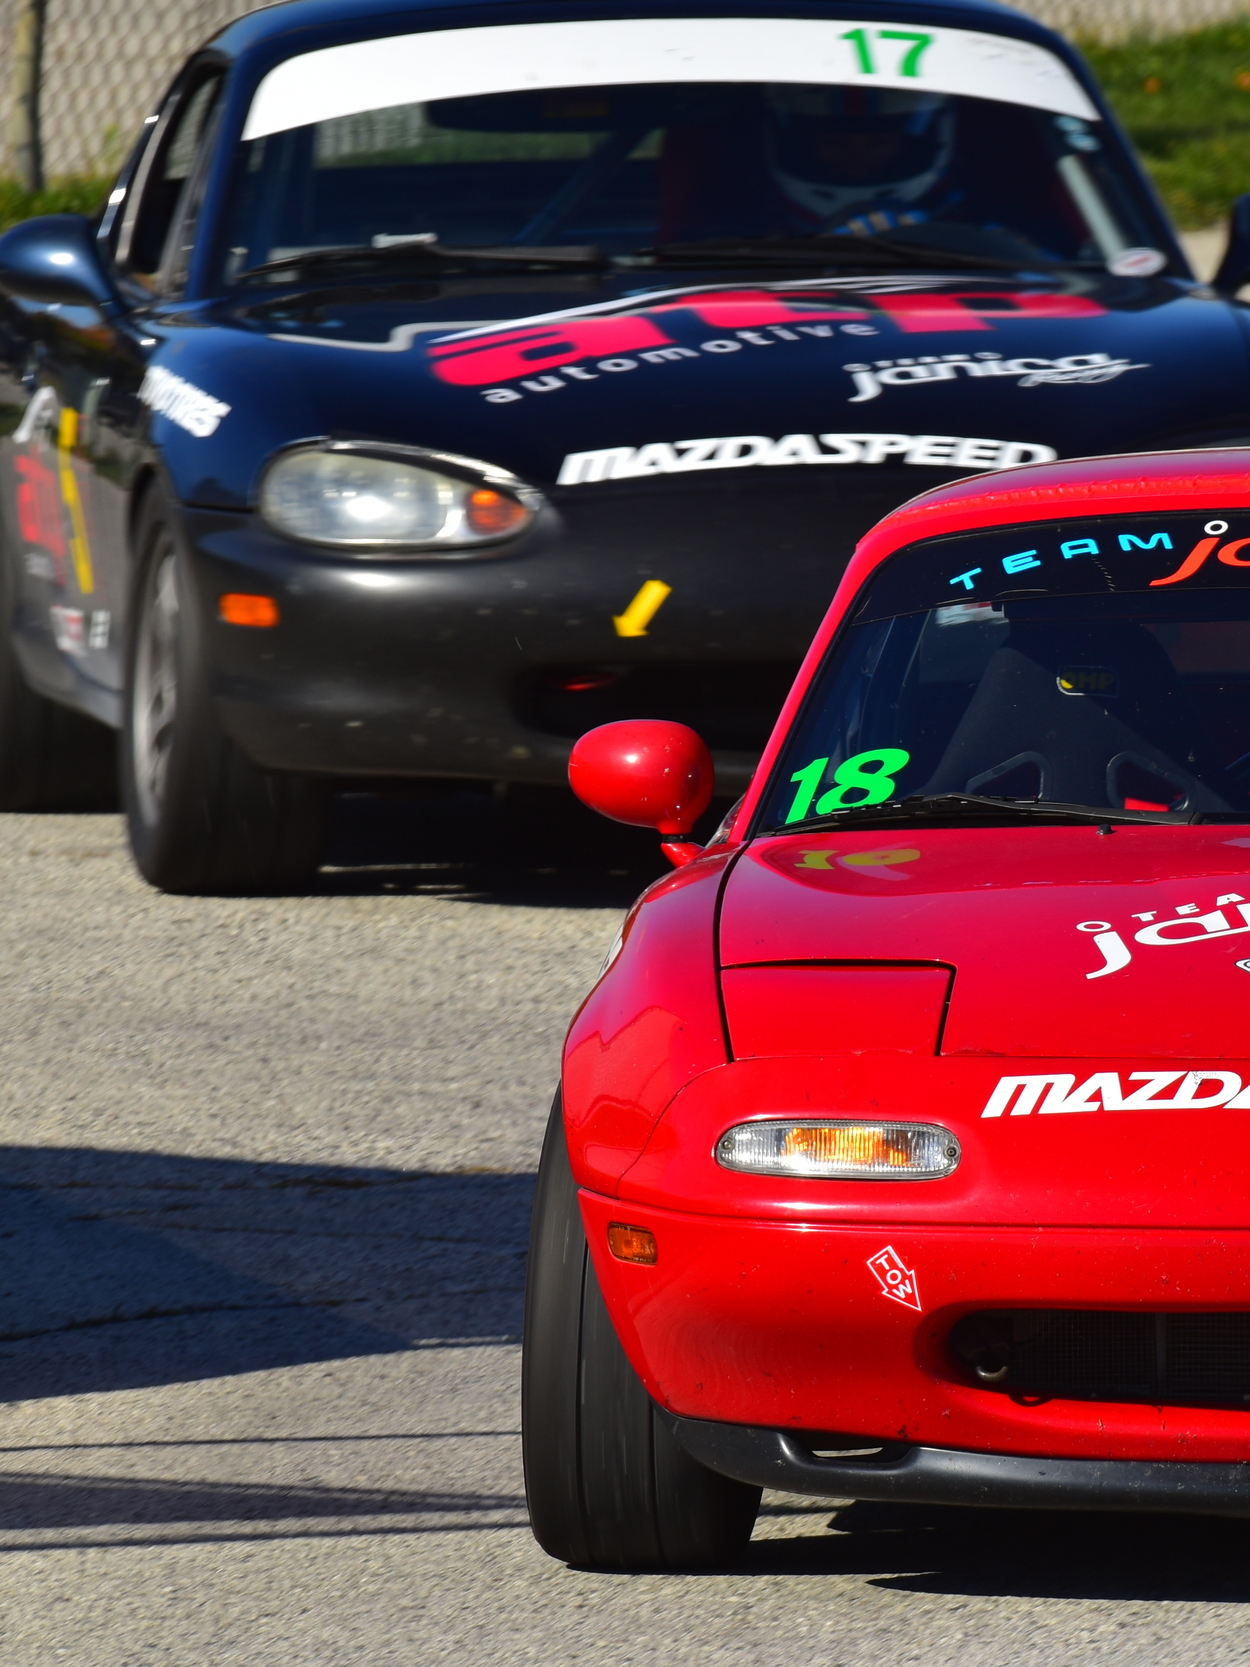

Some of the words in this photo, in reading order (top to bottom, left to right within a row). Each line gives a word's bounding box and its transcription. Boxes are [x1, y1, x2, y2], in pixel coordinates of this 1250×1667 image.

[838, 28, 934, 78] 17
[481, 322, 880, 402] automotive
[557, 433, 1058, 486] MAZDASPEED
[949, 532, 1174, 591] TEAM
[785, 748, 910, 825] 18
[875, 1254, 913, 1299] TOW
